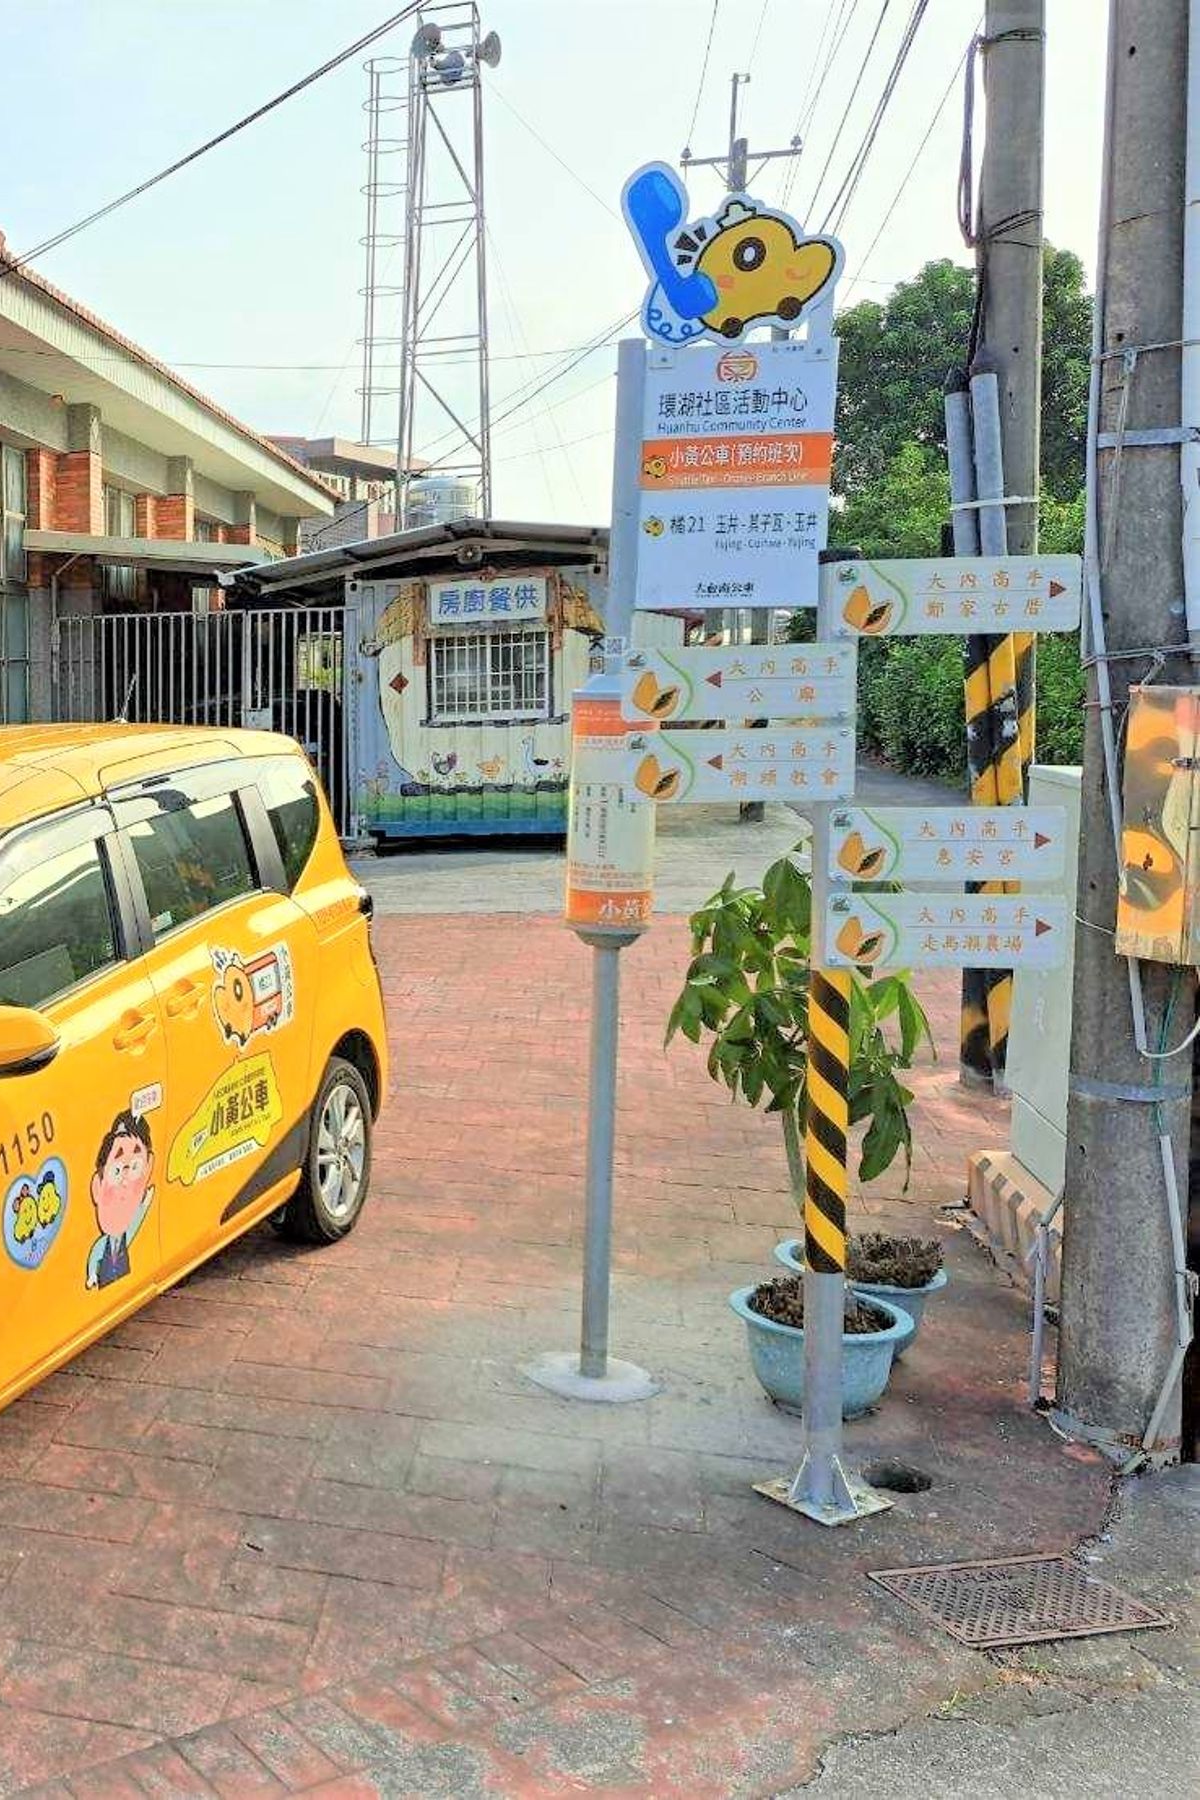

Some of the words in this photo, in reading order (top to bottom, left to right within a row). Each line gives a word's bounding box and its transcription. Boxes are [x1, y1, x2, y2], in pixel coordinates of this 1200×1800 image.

[658, 387, 808, 418] 環湖社區活動中心
[657, 421, 700, 435] Huanhu
[702, 418, 767, 433] Community
[769, 417, 807, 430] Center
[927, 568, 1044, 589] 大內高手
[728, 657, 839, 676] 大內高手
[729, 740, 839, 759] 大內高手
[919, 818, 1029, 838] 大內高手
[918, 906, 1031, 925] 大內高手
[210, 1079, 270, 1137] 小黃公車
